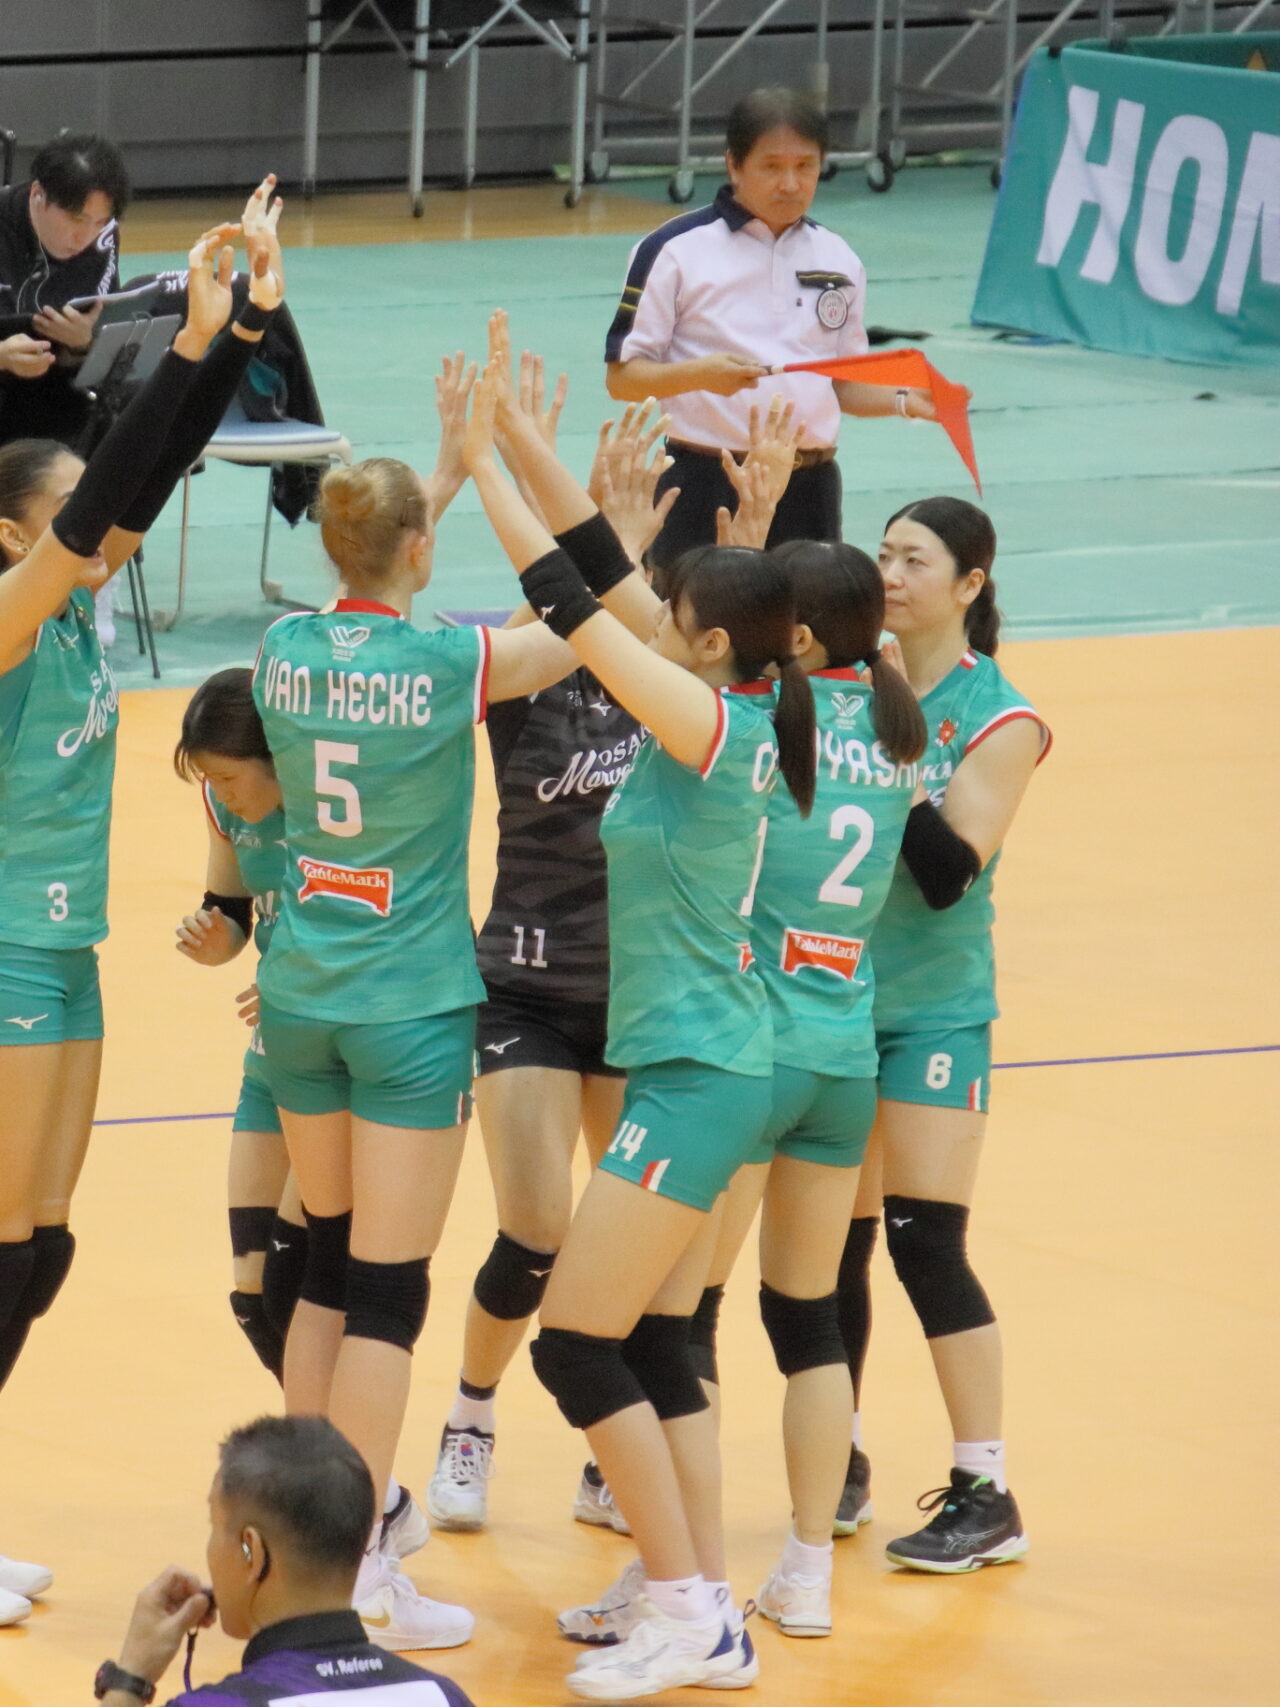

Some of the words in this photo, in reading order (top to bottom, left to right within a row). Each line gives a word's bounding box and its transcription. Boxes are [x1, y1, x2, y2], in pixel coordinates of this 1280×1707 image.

[265, 656, 311, 715] VAN
[327, 670, 433, 727] HECKE
[314, 739, 363, 838] 5
[302, 862, 387, 888] TableMark
[818, 804, 874, 907] 2
[47, 882, 69, 922] 3
[511, 925, 548, 968] 11
[792, 934, 860, 960] TableMark
[926, 1052, 953, 1090] 6
[607, 1120, 648, 1162] 14
[336, 1656, 384, 1675] Referee
